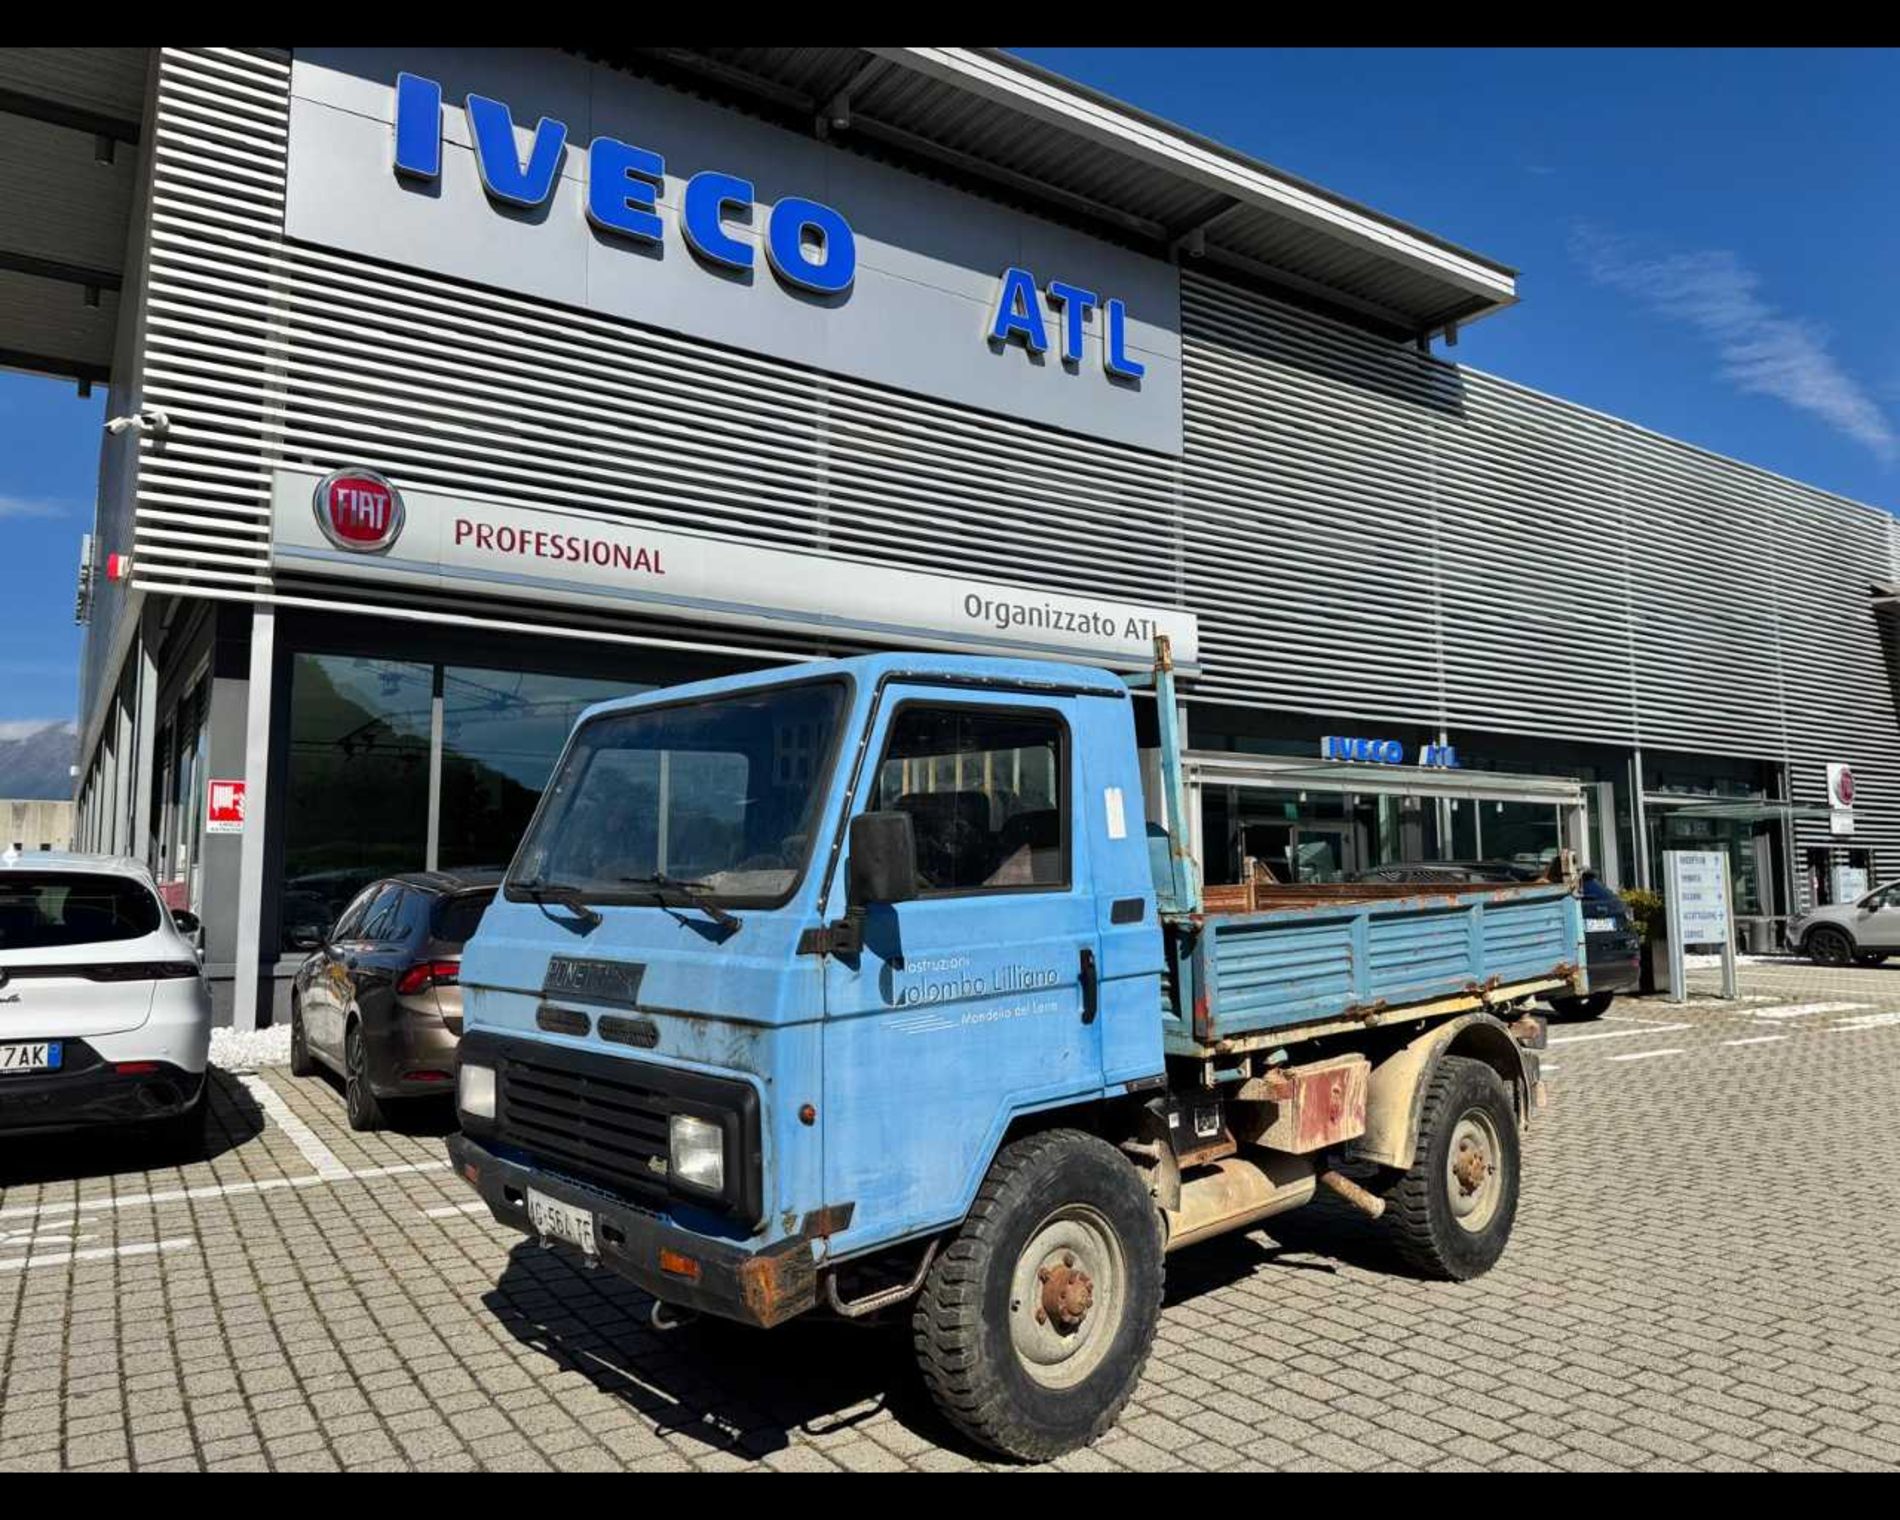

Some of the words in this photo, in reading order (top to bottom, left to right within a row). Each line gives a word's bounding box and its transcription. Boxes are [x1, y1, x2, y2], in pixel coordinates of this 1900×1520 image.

[393, 71, 857, 292] IVECO
[988, 266, 1146, 379] ATL
[336, 487, 387, 531] FIAT
[455, 518, 666, 576] PROFESSIONAL
[964, 593, 1117, 637] Organizzato
[1322, 735, 1404, 764] IVECO
